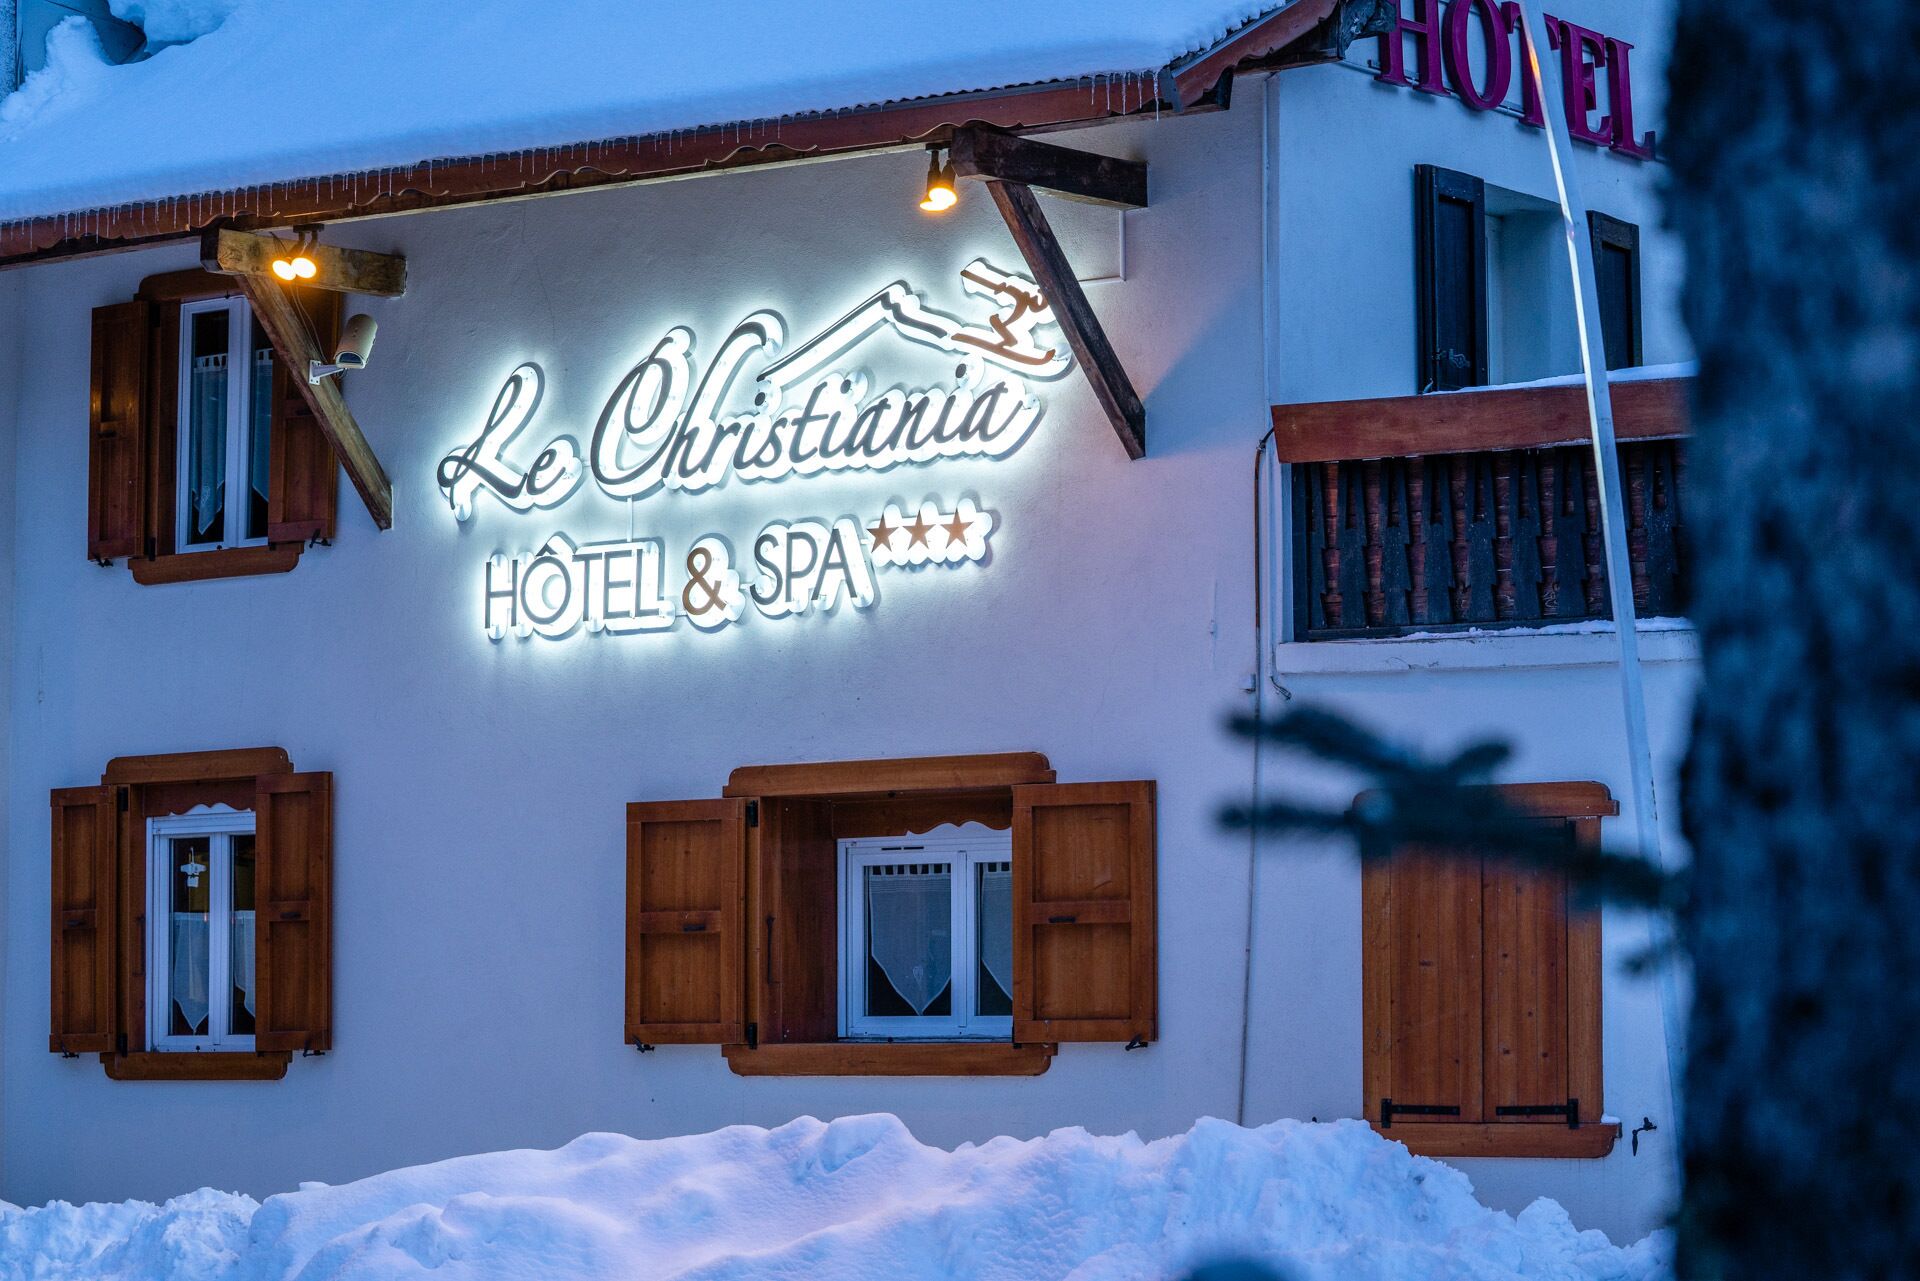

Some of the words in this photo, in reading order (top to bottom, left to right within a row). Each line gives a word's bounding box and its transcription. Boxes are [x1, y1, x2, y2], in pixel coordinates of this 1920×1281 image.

[1374, 0, 1656, 162] HOTEL
[437, 373, 567, 510] Le
[590, 320, 1024, 485] Christiania
[484, 539, 660, 629] HÔTEL
[682, 546, 728, 616] &
[750, 530, 862, 607] SPA
